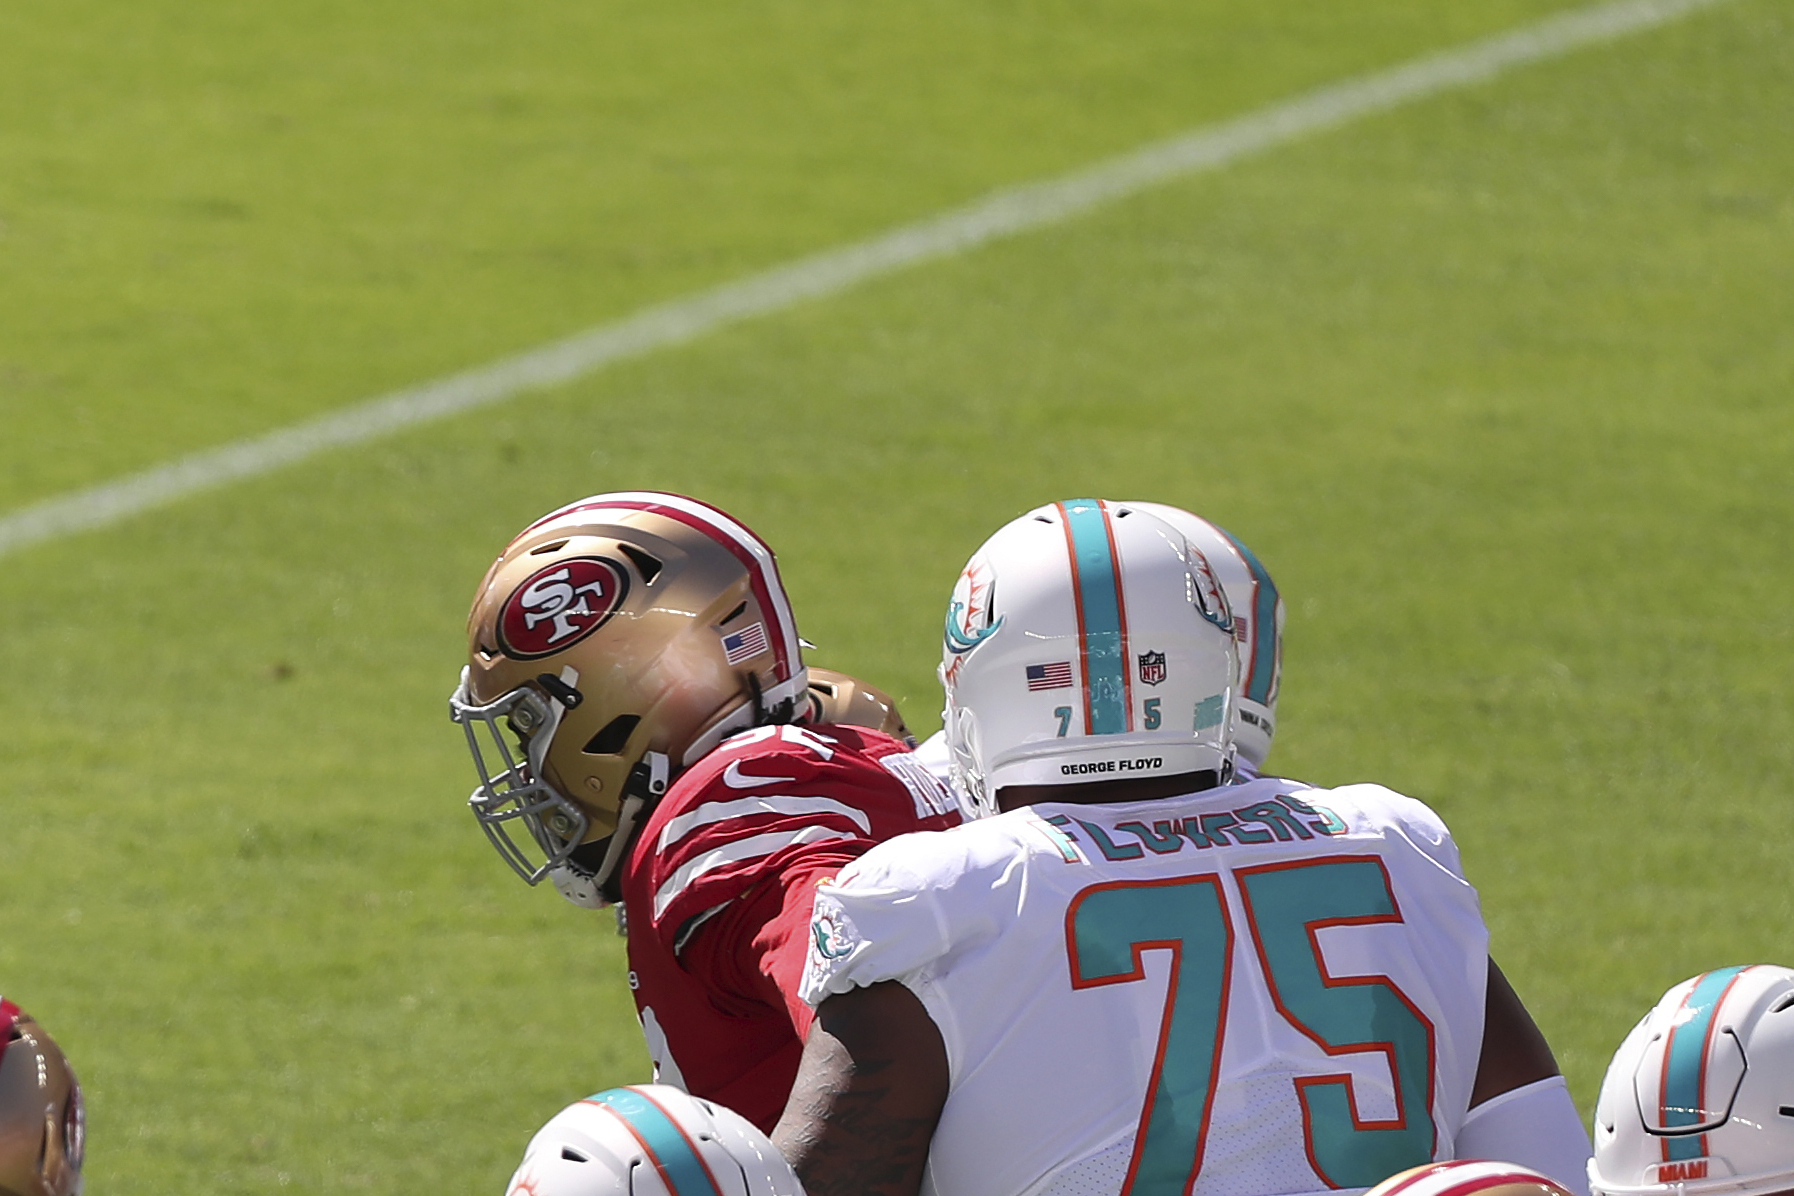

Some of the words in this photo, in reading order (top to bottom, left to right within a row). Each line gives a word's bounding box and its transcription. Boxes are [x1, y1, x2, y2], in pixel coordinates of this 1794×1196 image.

[1141, 665, 1165, 683] NFL
[1061, 760, 1116, 776] GEORGE
[1118, 757, 1163, 771] FLOYD
[1028, 794, 1350, 864] FLOWERS
[1658, 1160, 1708, 1183] MIAMI
